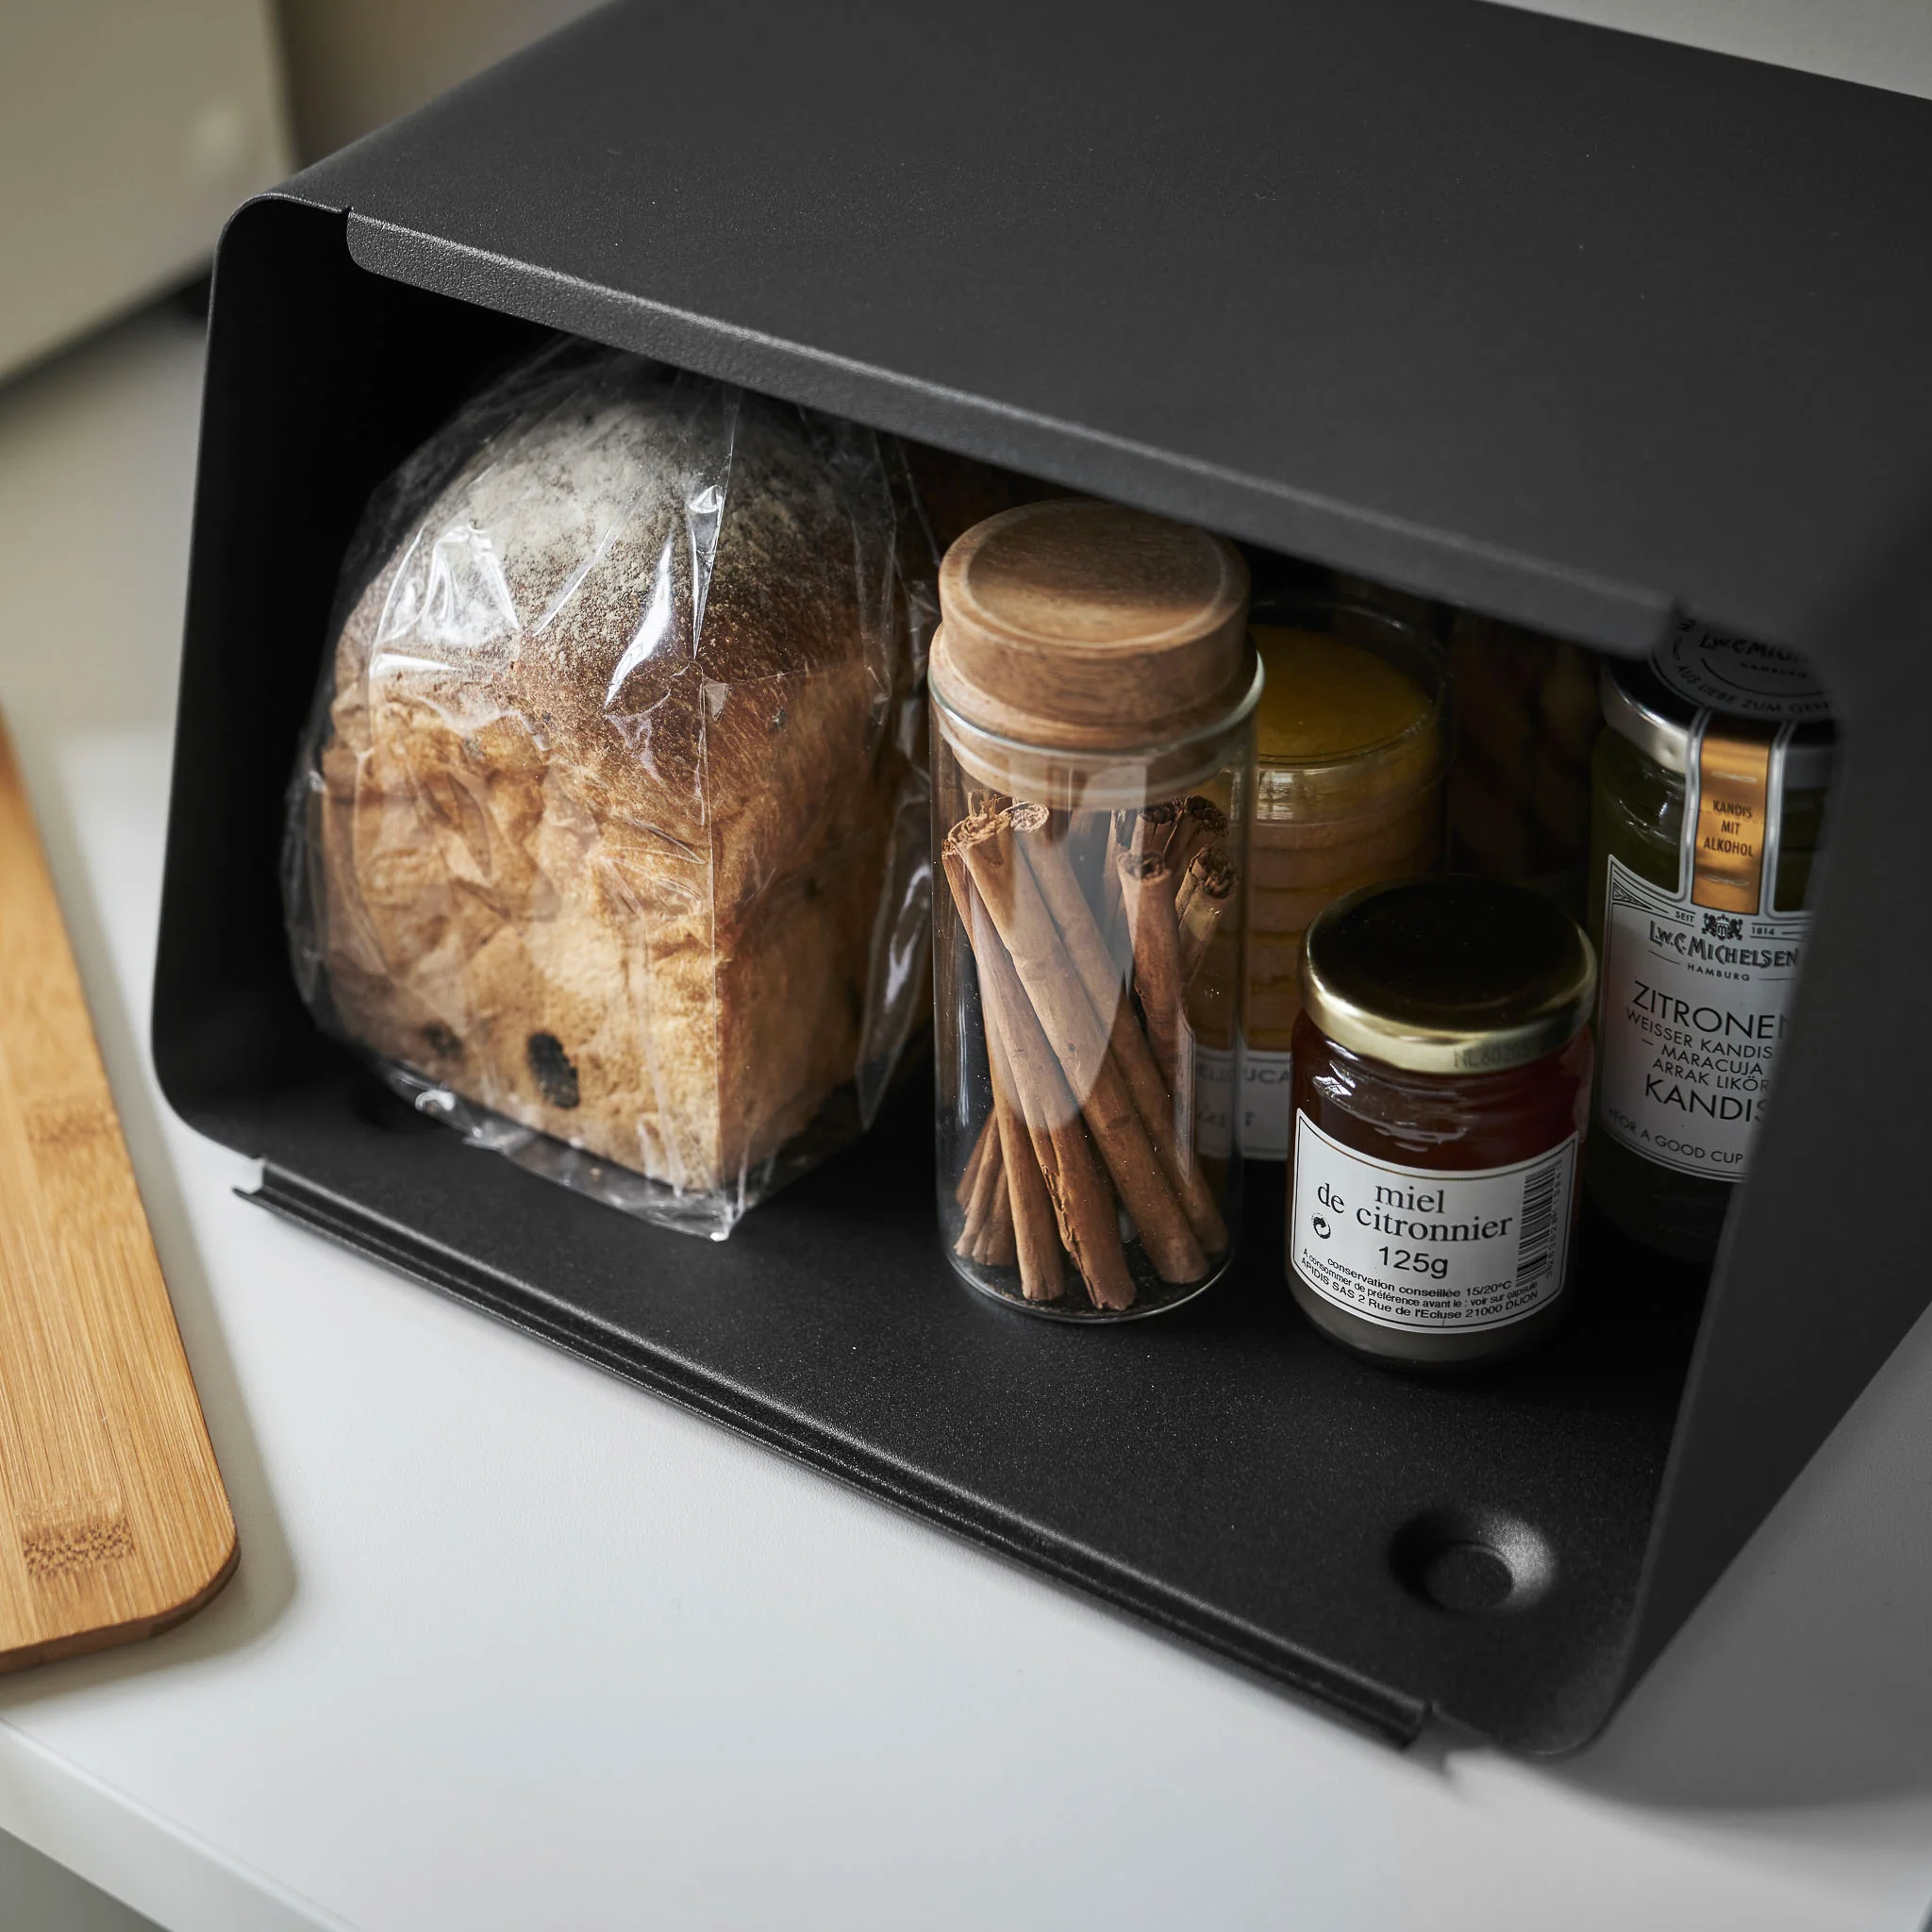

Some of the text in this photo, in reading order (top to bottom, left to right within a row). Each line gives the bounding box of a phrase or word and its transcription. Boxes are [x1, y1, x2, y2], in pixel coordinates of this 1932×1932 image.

[1675, 665, 1701, 685] AUS
[1698, 682, 1738, 705] LIEBE
[1741, 699, 1781, 712] ZUM
[1712, 799, 1753, 818] KANDIS
[1721, 820, 1740, 834] MIT
[1703, 837, 1755, 858] ALKOHOL
[1674, 909, 1774, 936] SEIT 1814
[1688, 963, 1751, 982] HAMBURG
[1625, 1006, 1773, 1059] WEISSER KANDIS
[1652, 1058, 1770, 1092] ARRAK LIKÖR
[1661, 1044, 1763, 1075] MARACUJA
[1641, 1129, 1651, 1142] A
[1655, 1135, 1706, 1158] GOOD
[1710, 1151, 1744, 1164] CUP
[1317, 1183, 1513, 1242] de citronnier
[1374, 1186, 1445, 1214] miel
[1327, 1257, 1395, 1291] conservation
[1398, 1286, 1461, 1298] conseillée
[1378, 1245, 1449, 1280] 125g
[1302, 1257, 1330, 1286] APIDIS
[1332, 1281, 1355, 1300] SAS
[1357, 1294, 1365, 1305] 2
[1368, 1298, 1392, 1312] Rue
[1395, 1307, 1411, 1317] de
[1465, 1304, 1503, 1319] 21000
[1506, 1290, 1539, 1311] DIJON
[1308, 1255, 1352, 1287] consommer
[1354, 1282, 1366, 1292] de
[1367, 1288, 1421, 1307] préférence
[1423, 1298, 1451, 1308] avant
[1453, 1298, 1462, 1308] le
[1470, 1295, 1488, 1307] voir
[1490, 1293, 1505, 1305] sur
